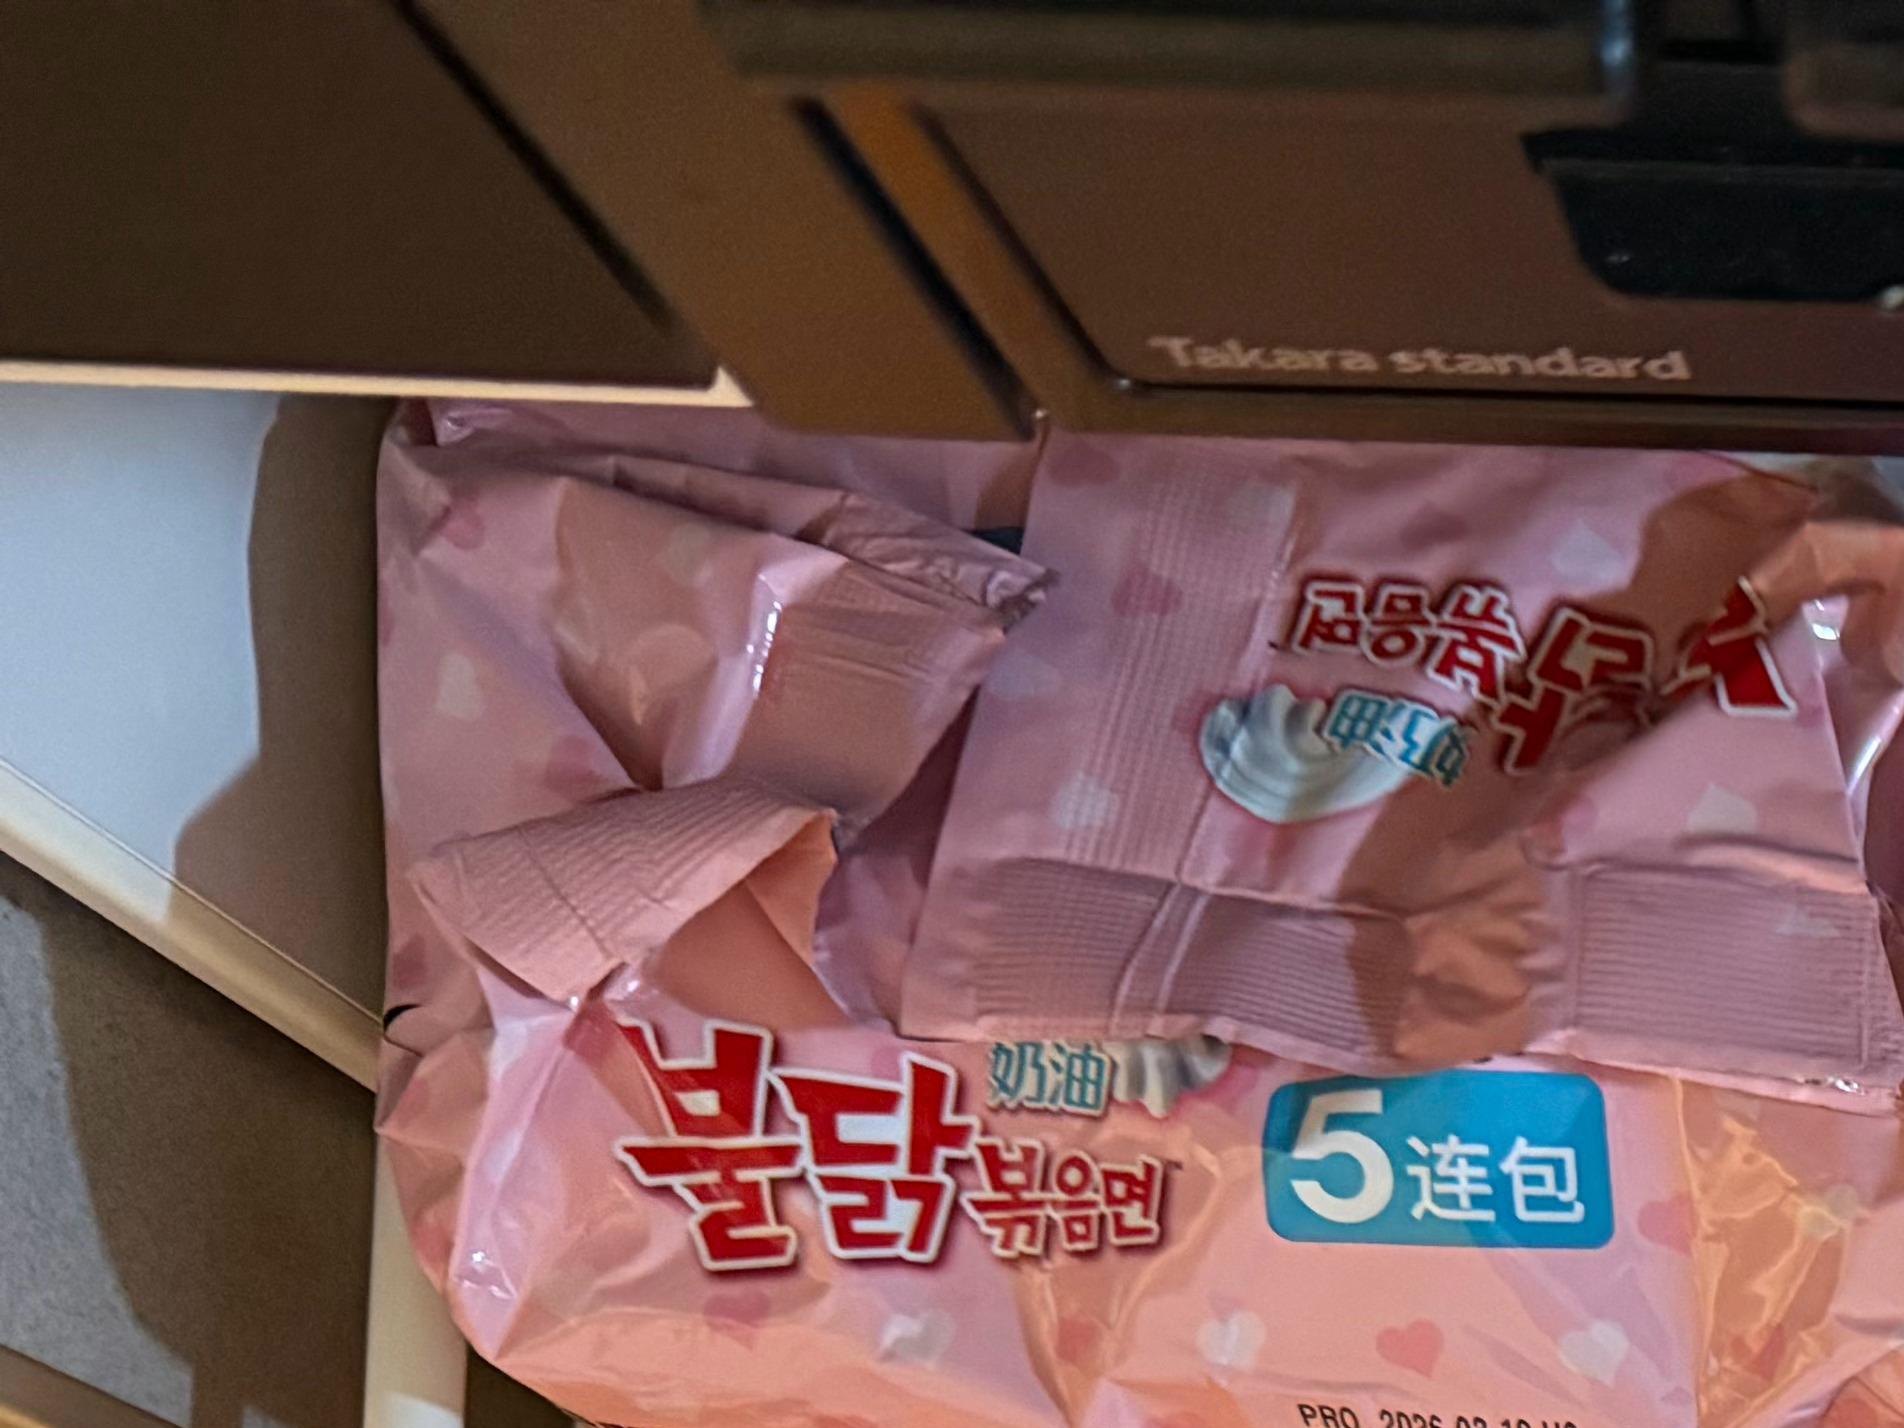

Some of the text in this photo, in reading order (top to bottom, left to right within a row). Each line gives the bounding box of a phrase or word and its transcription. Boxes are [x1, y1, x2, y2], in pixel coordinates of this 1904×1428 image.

[1146, 335, 1691, 381] Takara standard
[989, 1040, 1112, 1116] 奶油
[1290, 1089, 1585, 1224] 5连包
